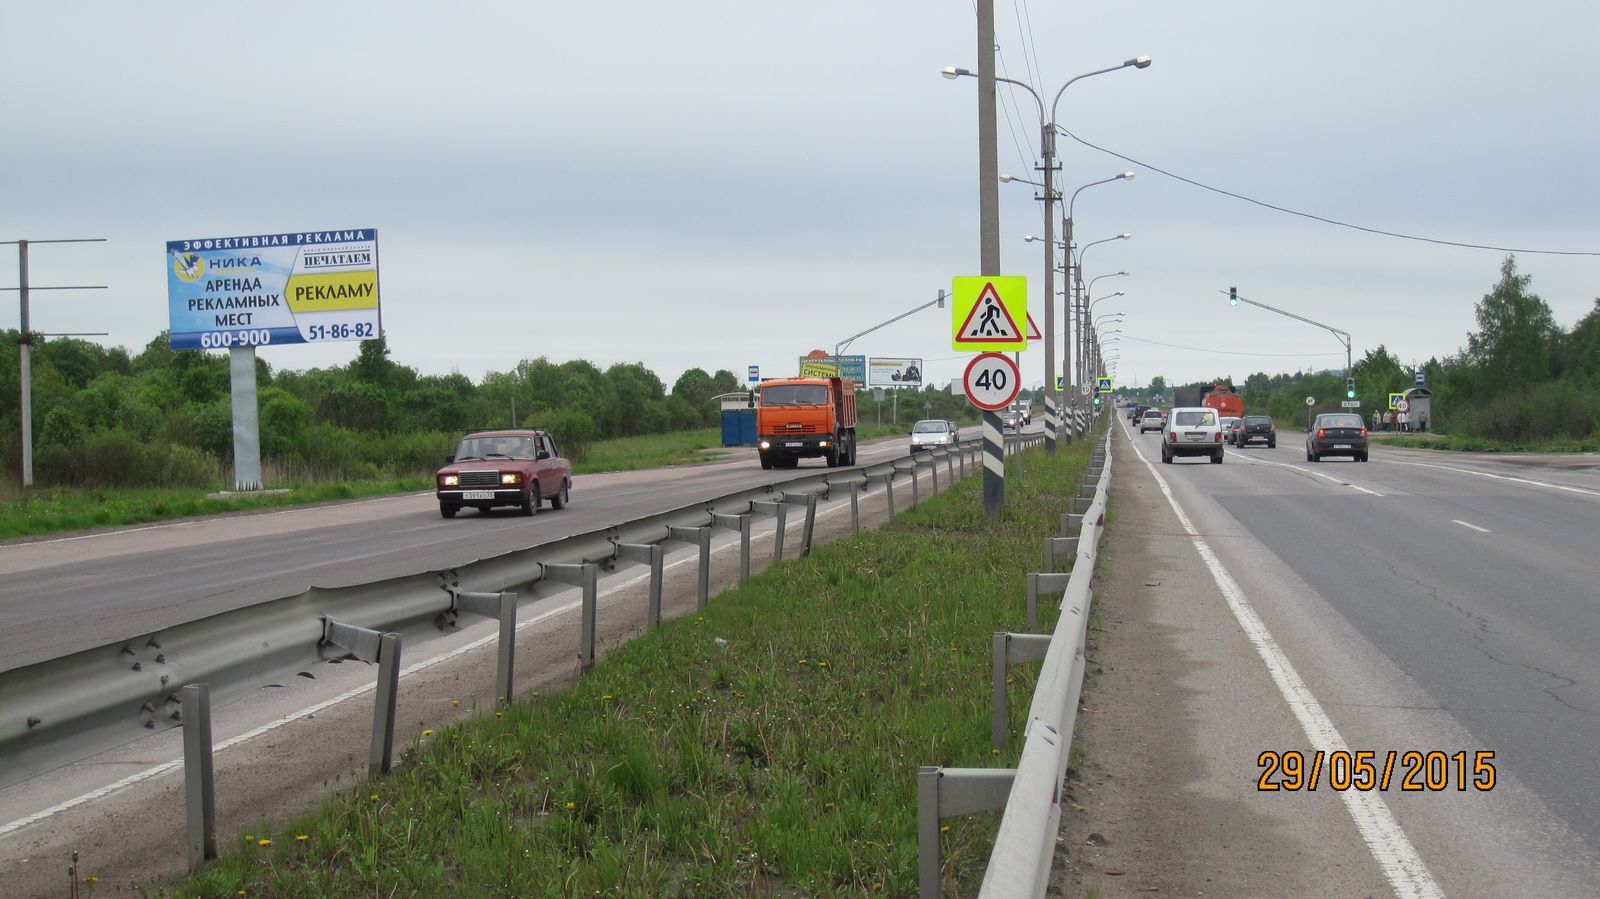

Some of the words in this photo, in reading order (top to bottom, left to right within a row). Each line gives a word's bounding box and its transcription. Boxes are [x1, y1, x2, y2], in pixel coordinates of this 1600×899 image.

[183, 235, 289, 251] ЭФФЕКТИВНАЯ
[296, 230, 365, 243] РЕКЛАМА
[209, 256, 262, 269] НИКА
[304, 252, 371, 266] ПЕЧАТАЕМ
[205, 277, 262, 292] АРЕНДА
[295, 283, 374, 301] РЕКЛАМУ
[188, 293, 280, 311] РЕКЛАМНЫХ
[215, 312, 253, 327] МЕСТ
[200, 329, 271, 347] 600-900
[309, 322, 373, 340] 51-86-82
[975, 368, 1007, 391] 40
